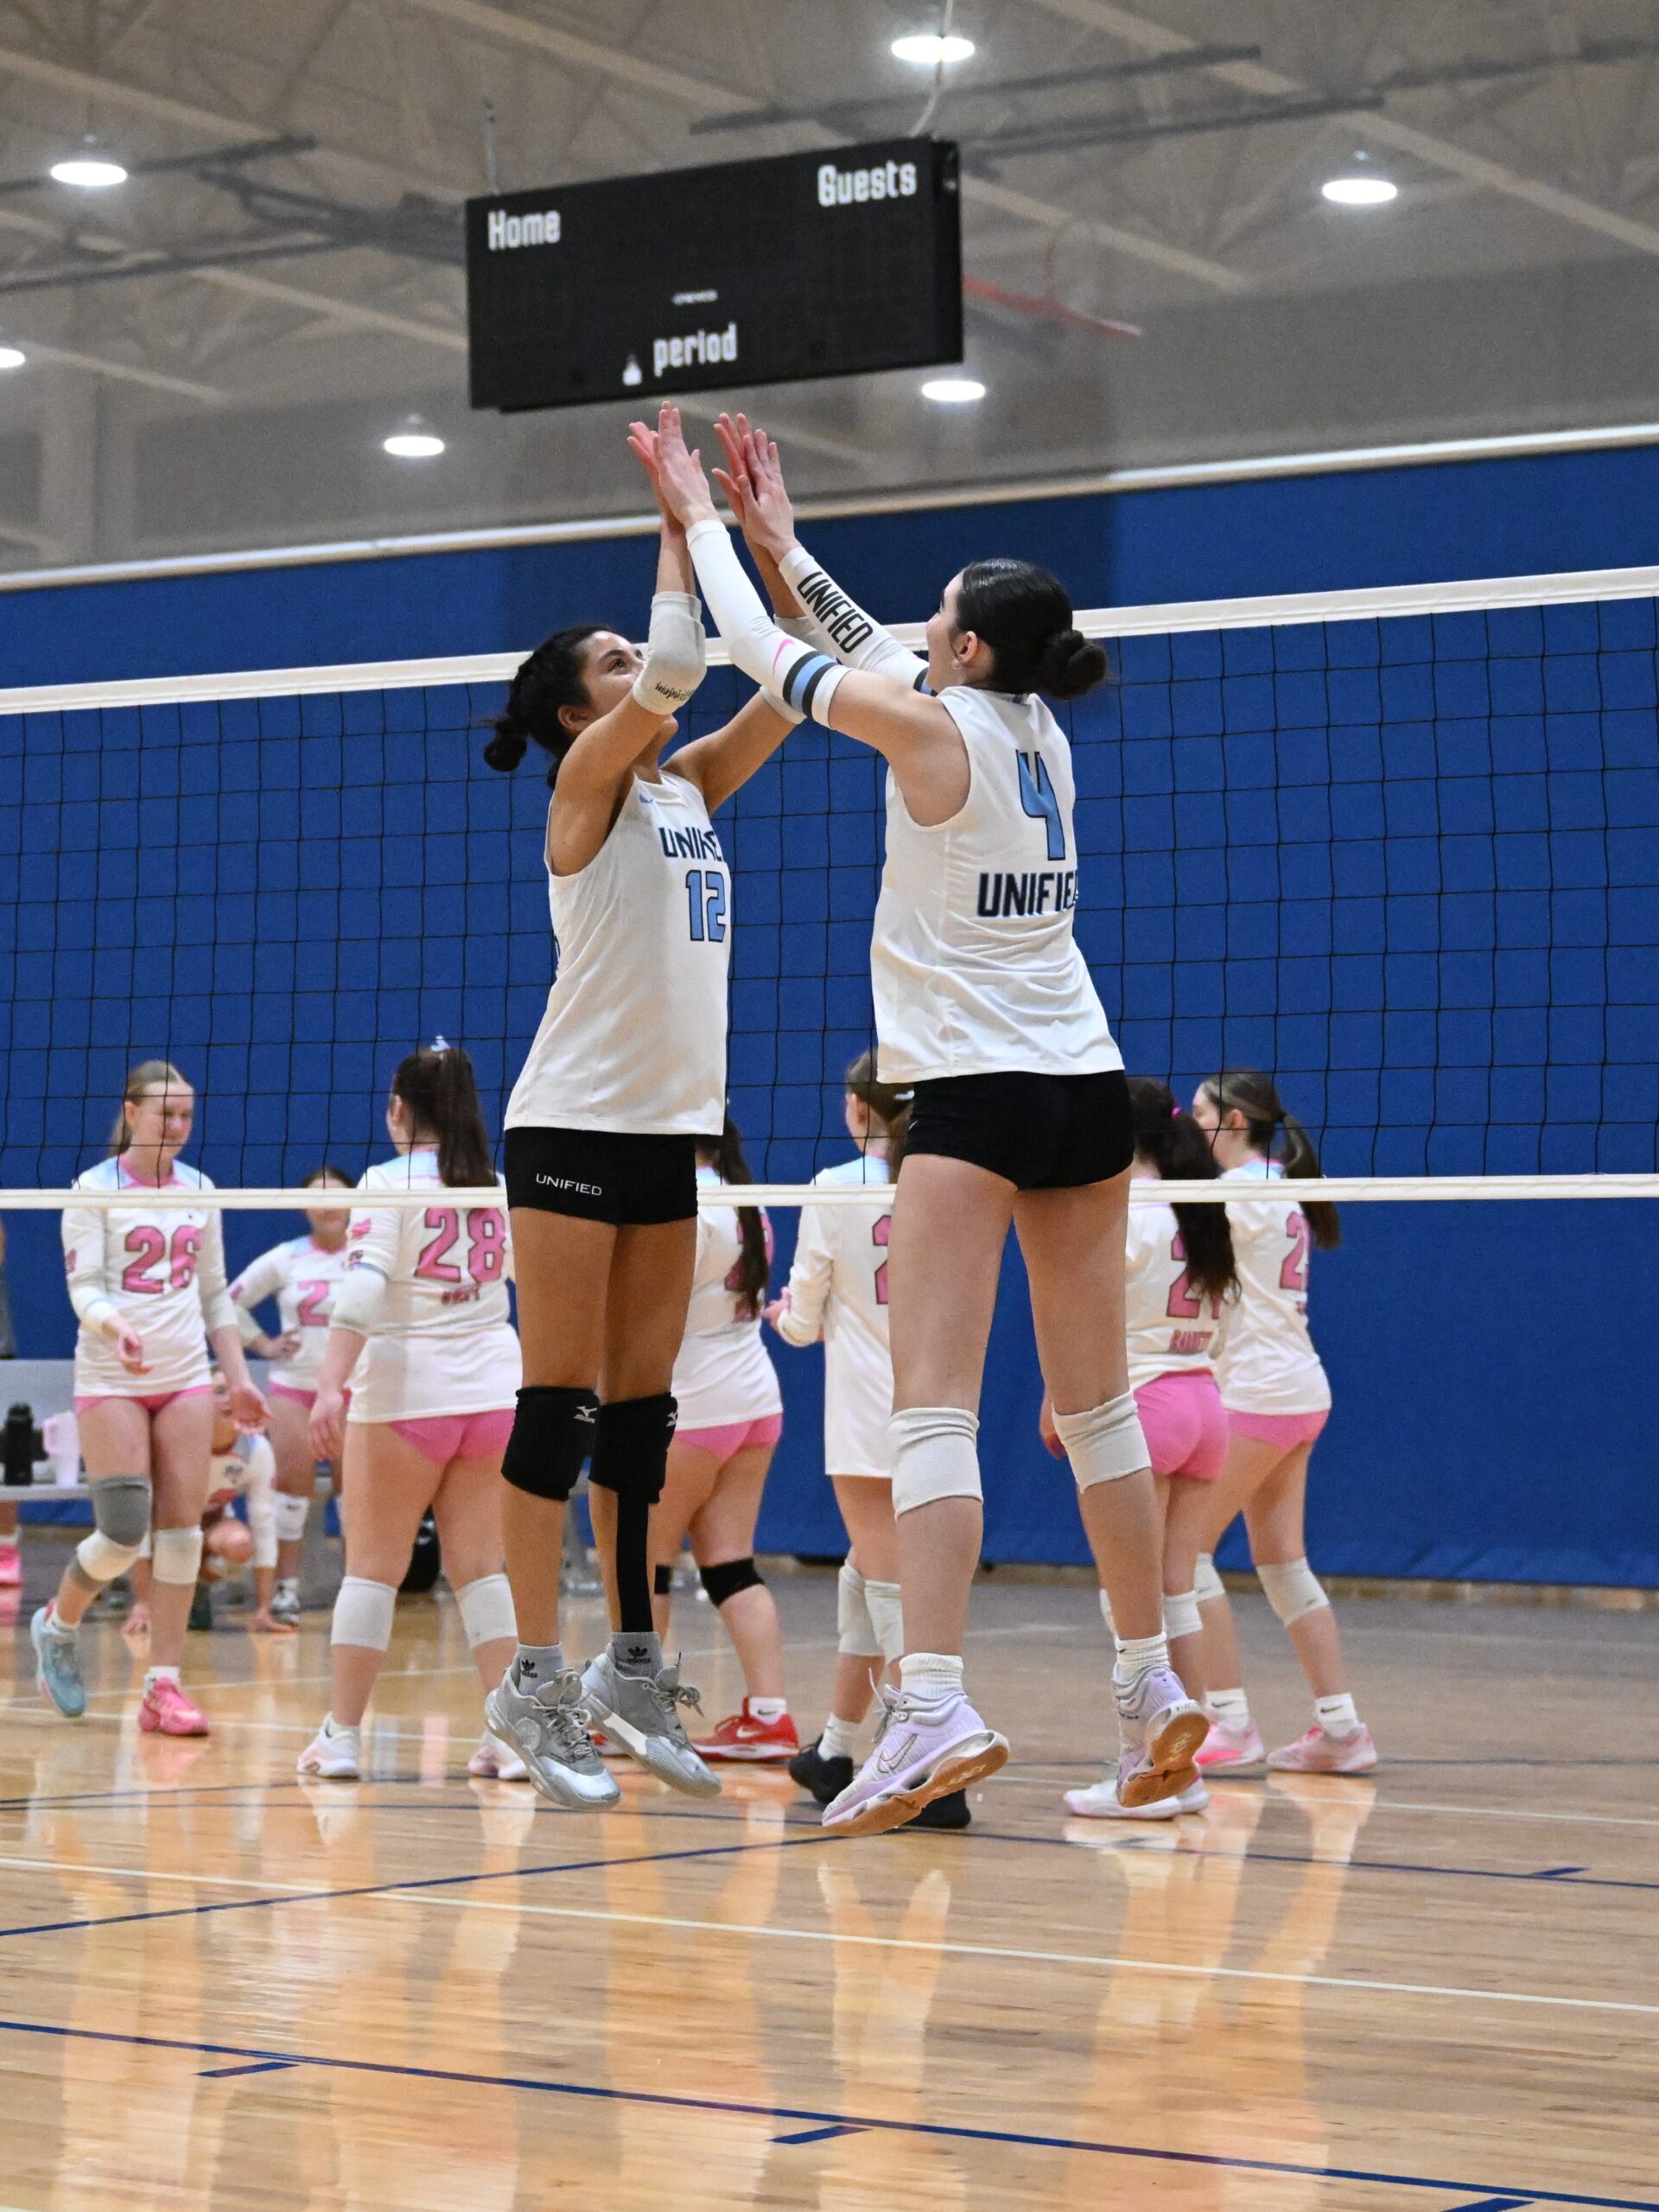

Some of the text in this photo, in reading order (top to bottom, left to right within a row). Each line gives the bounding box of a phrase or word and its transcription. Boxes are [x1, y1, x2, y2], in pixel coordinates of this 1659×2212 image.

[817, 160, 917, 207] Guests
[487, 210, 561, 251] Home
[653, 321, 737, 378] period
[797, 571, 874, 654] UNIFIED
[1015, 749, 1066, 861] 4
[685, 869, 726, 943] 12
[977, 872, 1078, 918] UNIFIE
[536, 1173, 602, 1196] UNIFIED
[413, 1207, 506, 1284] 28
